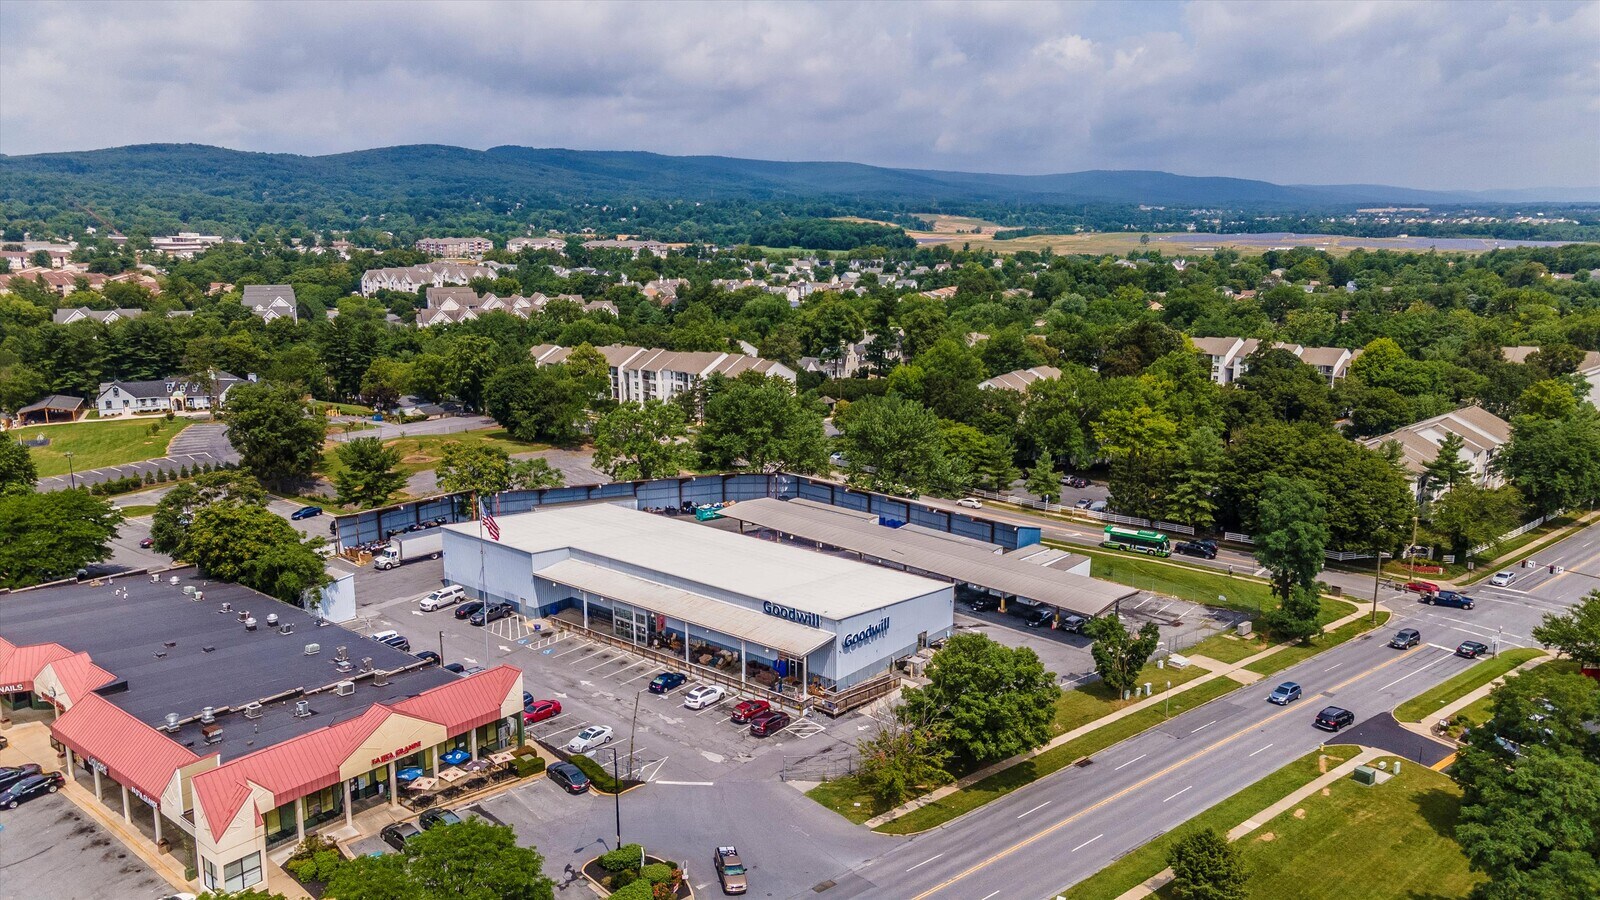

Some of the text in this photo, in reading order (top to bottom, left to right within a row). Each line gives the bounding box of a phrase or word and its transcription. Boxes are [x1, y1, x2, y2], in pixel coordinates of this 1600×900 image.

[763, 600, 820, 627] Goodwill
[843, 616, 890, 647] Goodwill
[0, 683, 23, 692] NAILS
